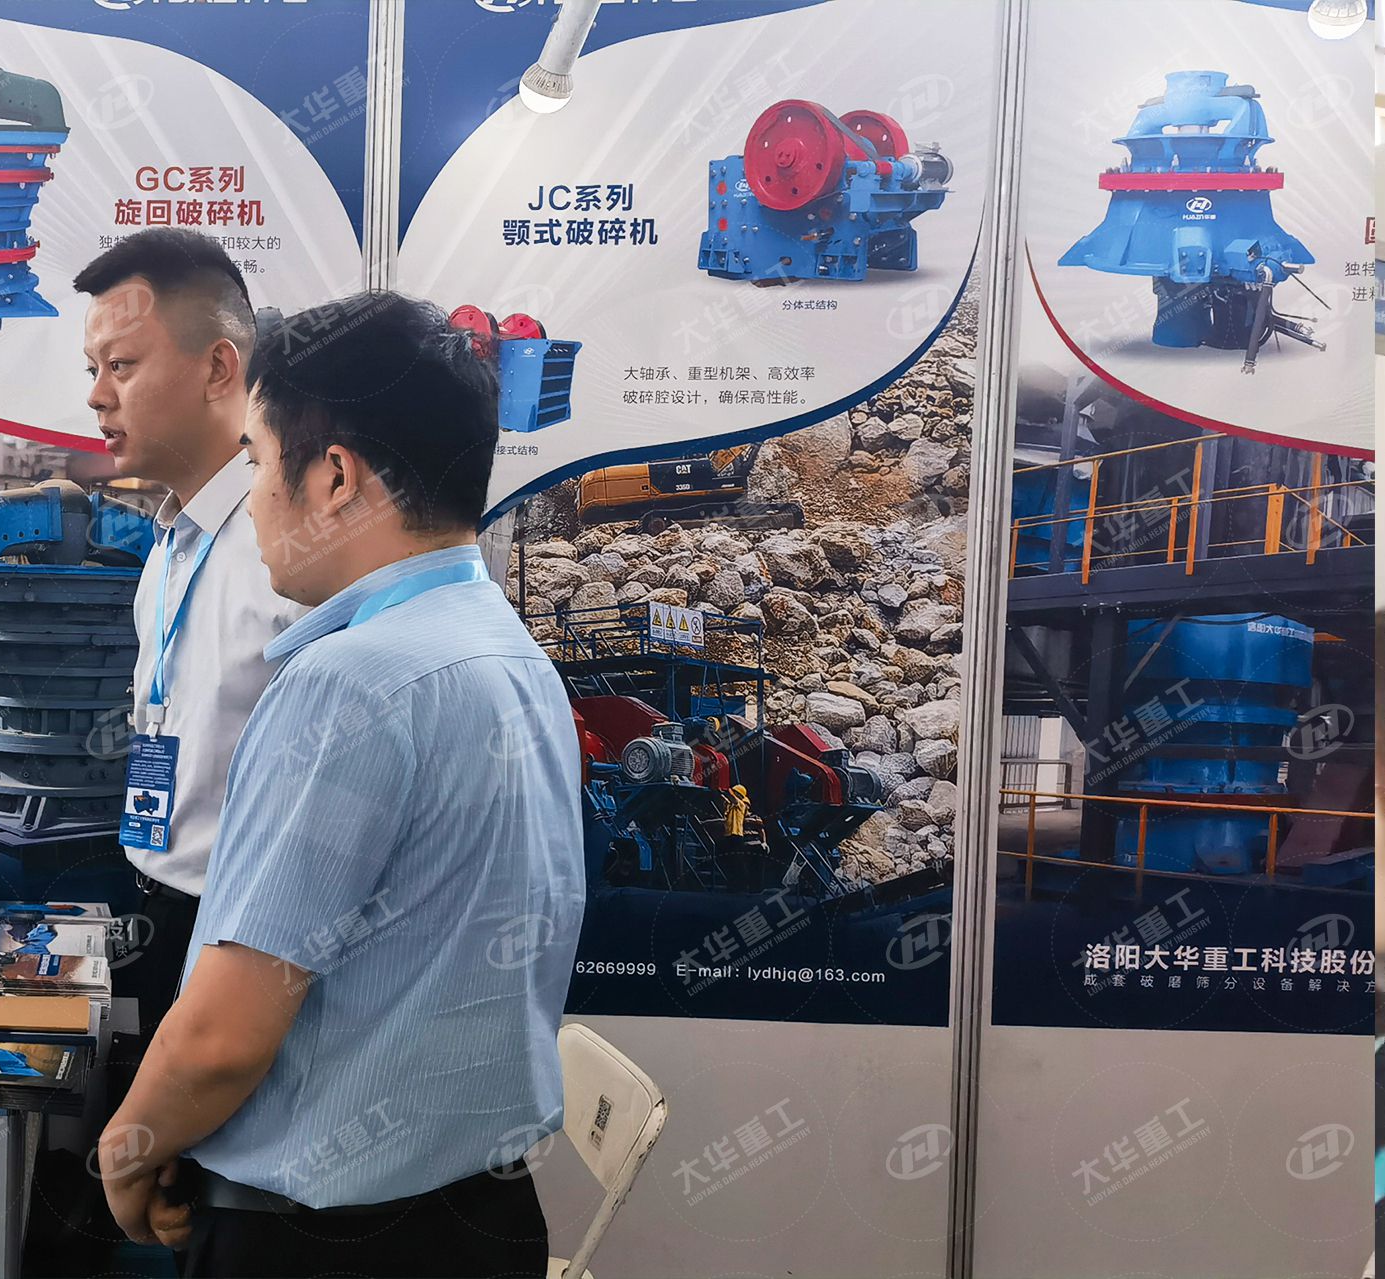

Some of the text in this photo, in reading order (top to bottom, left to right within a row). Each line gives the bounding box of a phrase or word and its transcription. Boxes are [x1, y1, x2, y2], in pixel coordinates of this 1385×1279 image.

[136, 166, 245, 193] GC系列
[528, 183, 634, 212] JC系列
[115, 199, 265, 226] 旋回破碎机
[502, 217, 659, 246] 颚式破碎机
[781, 300, 838, 311] 分体式结构
[623, 366, 816, 381] 大轴承、重型机架、高效率
[494, 445, 539, 456] 接式结构
[676, 464, 692, 475] CAT
[1085, 943, 1375, 975] 洛阳大华重工科技股份
[576, 961, 657, 976] 62669999
[747, 966, 886, 983] lydhjq@163.com
